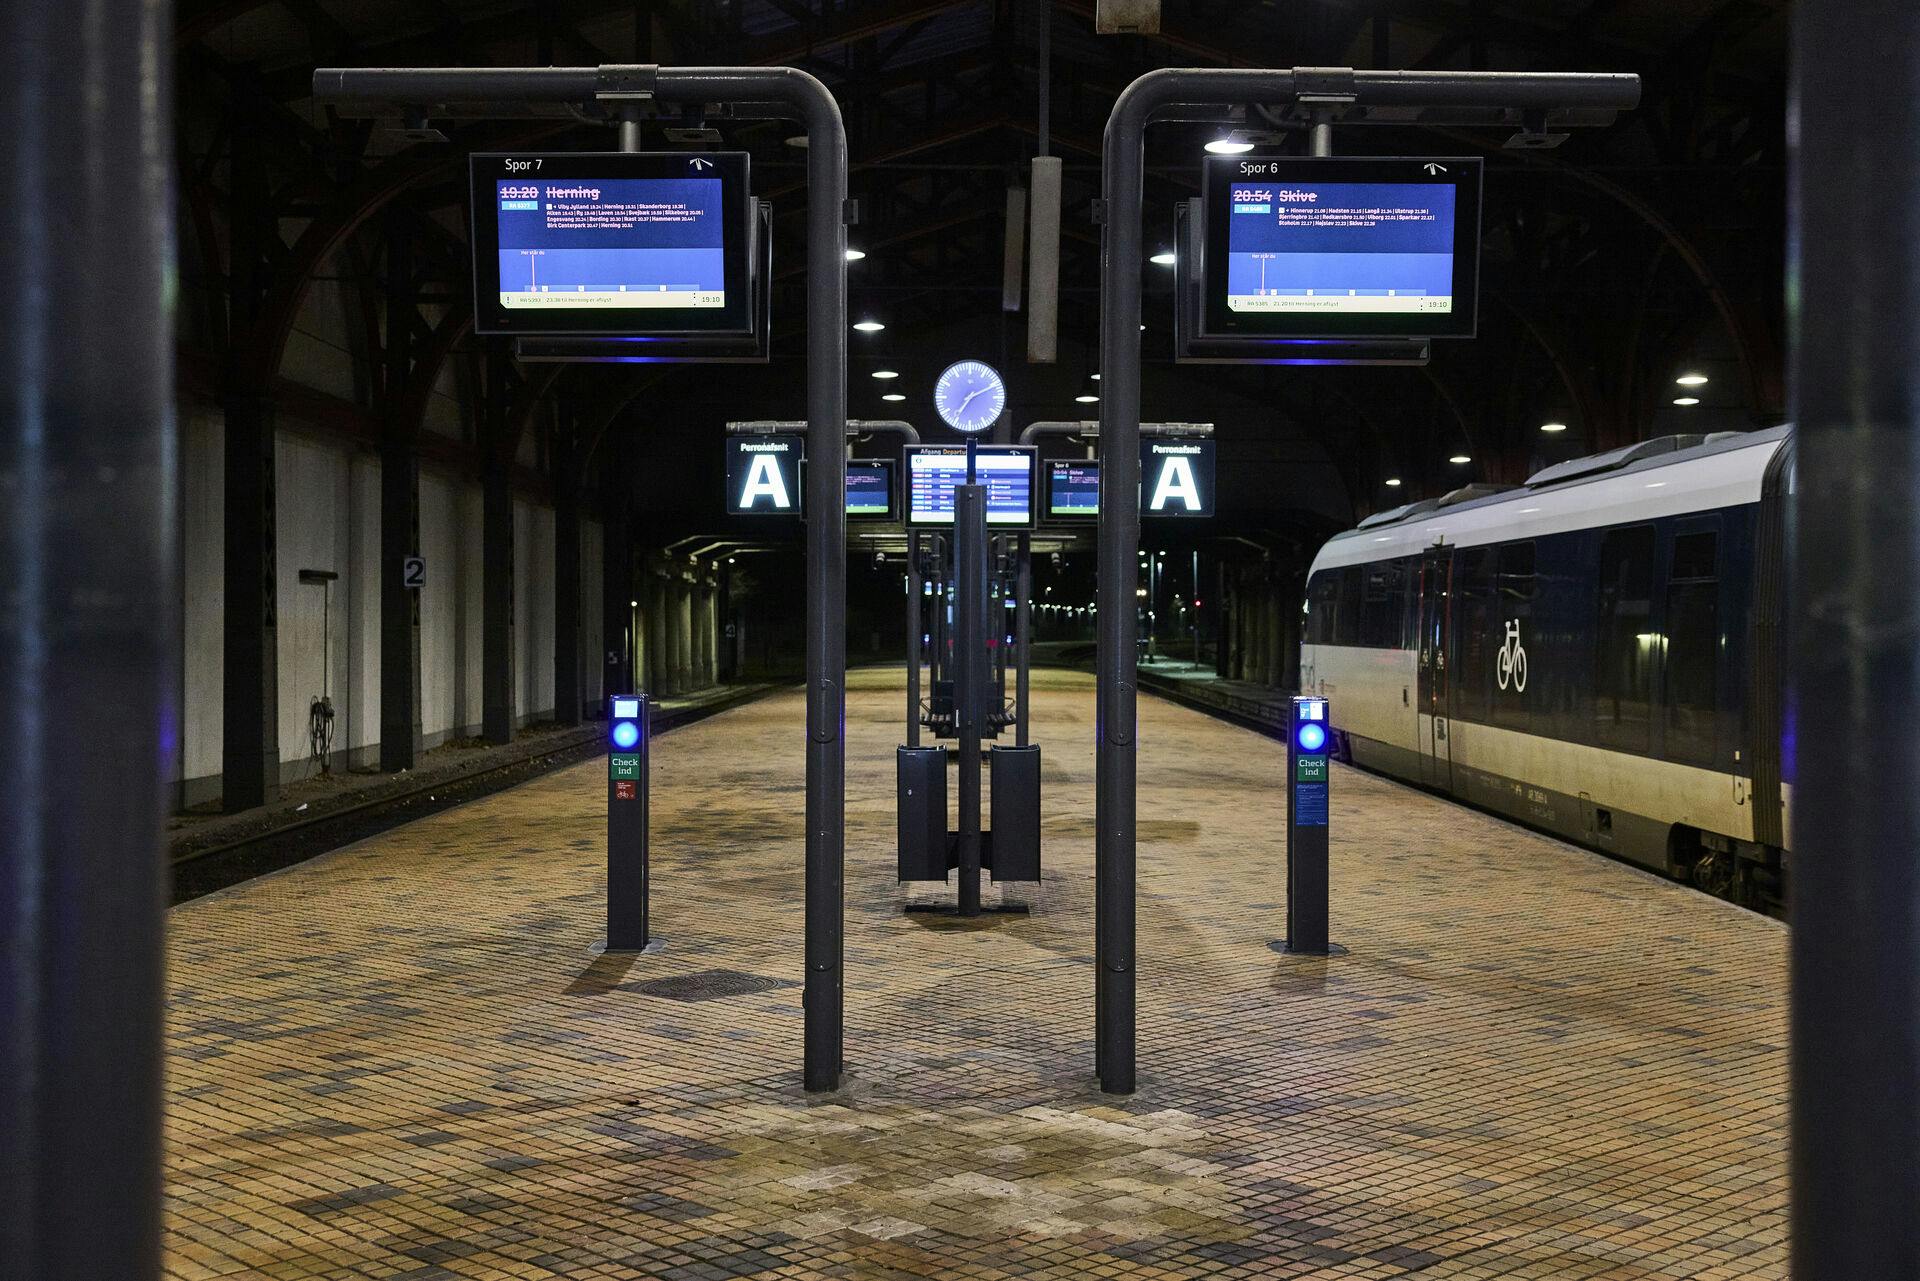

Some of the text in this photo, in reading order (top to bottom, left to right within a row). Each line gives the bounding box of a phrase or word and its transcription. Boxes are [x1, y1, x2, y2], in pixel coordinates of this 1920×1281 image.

[505, 158, 542, 172] Spor 7
[1240, 162, 1278, 176] Spor 6
[501, 186, 600, 200] 19.20 Herning
[1234, 190, 1317, 202] 20.54 Skive
[740, 442, 788, 452] Perronafsnit
[1152, 445, 1202, 454] Perronafsnit
[739, 454, 790, 508] A
[1150, 456, 1202, 510] A
[406, 560, 424, 584] 2
